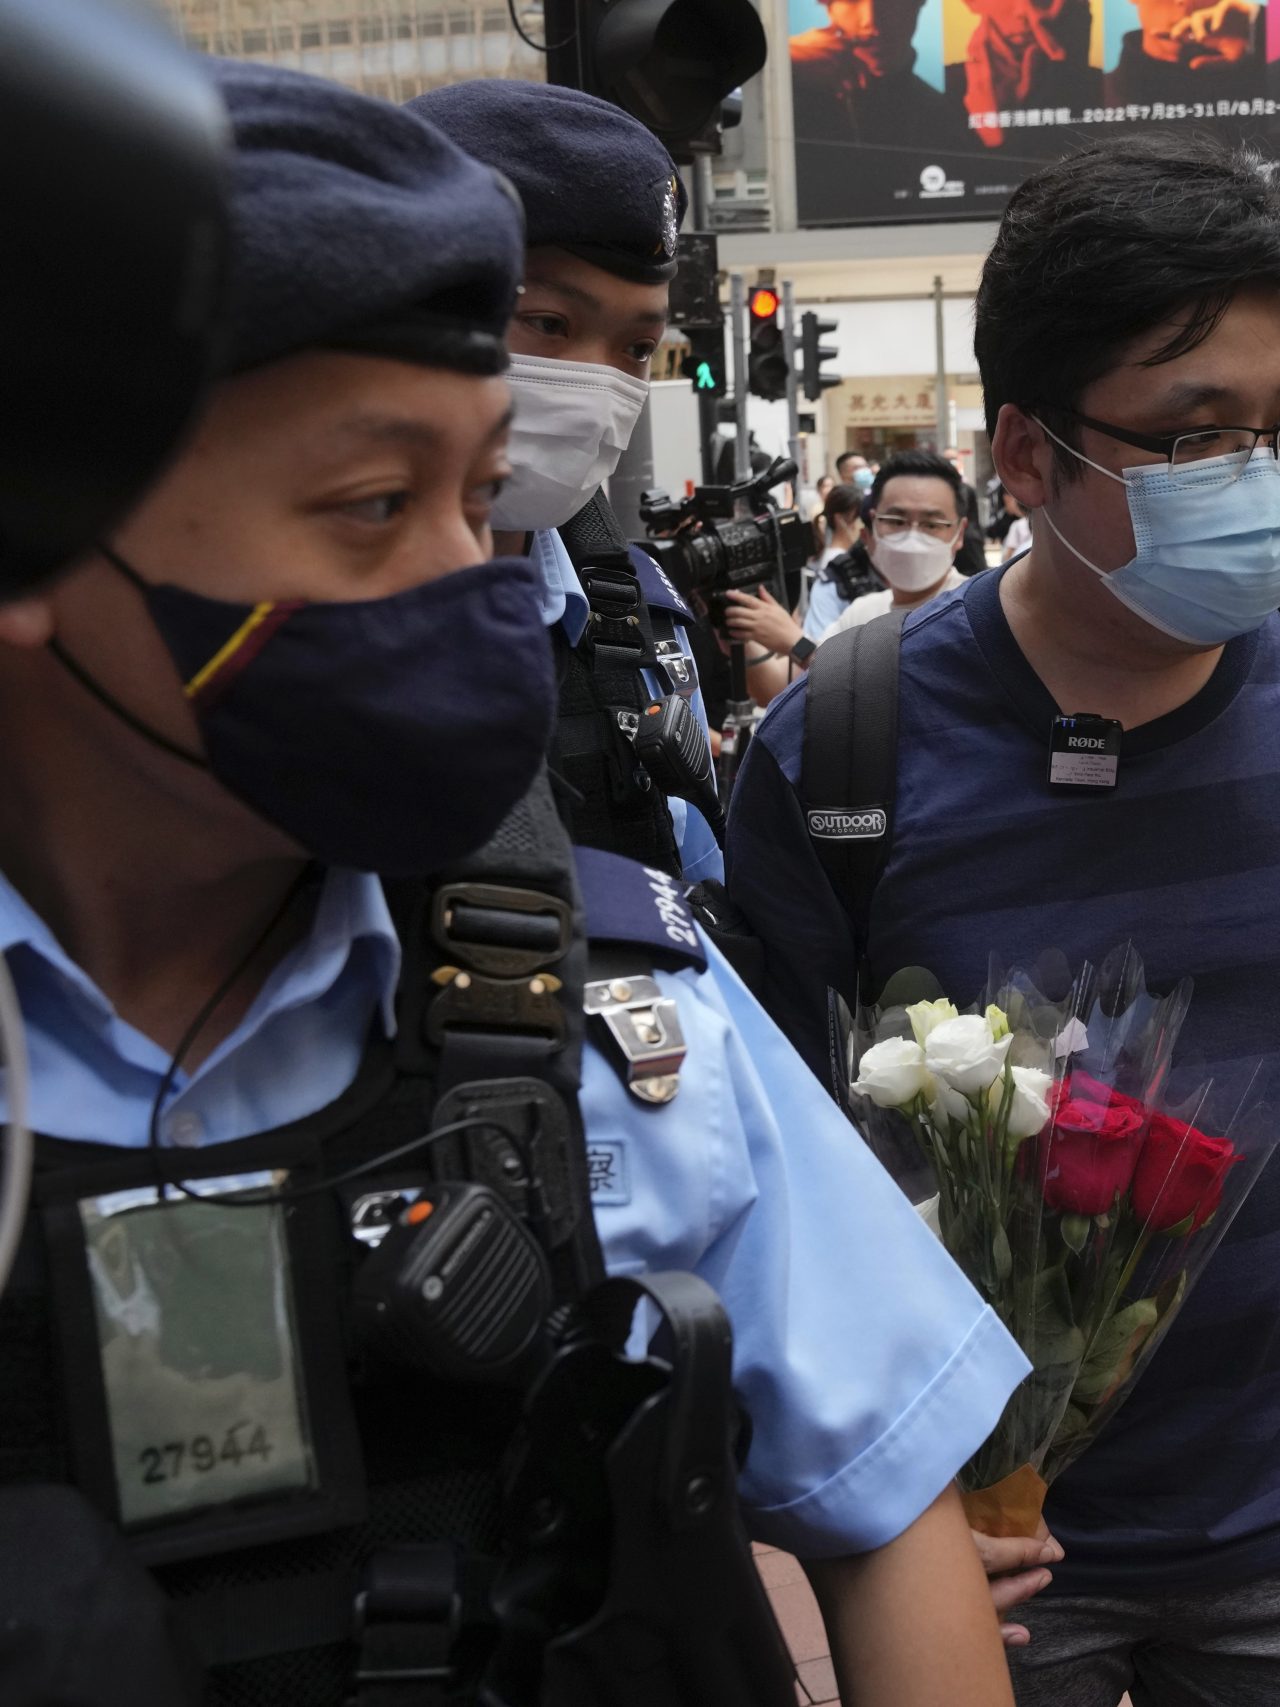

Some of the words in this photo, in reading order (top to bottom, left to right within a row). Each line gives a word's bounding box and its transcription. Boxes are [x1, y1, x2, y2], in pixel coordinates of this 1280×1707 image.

[1068, 736, 1106, 749] RØDE
[811, 814, 881, 831] OUTDOOR
[642, 867, 698, 947] 27944
[139, 1420, 273, 1486] 27944
